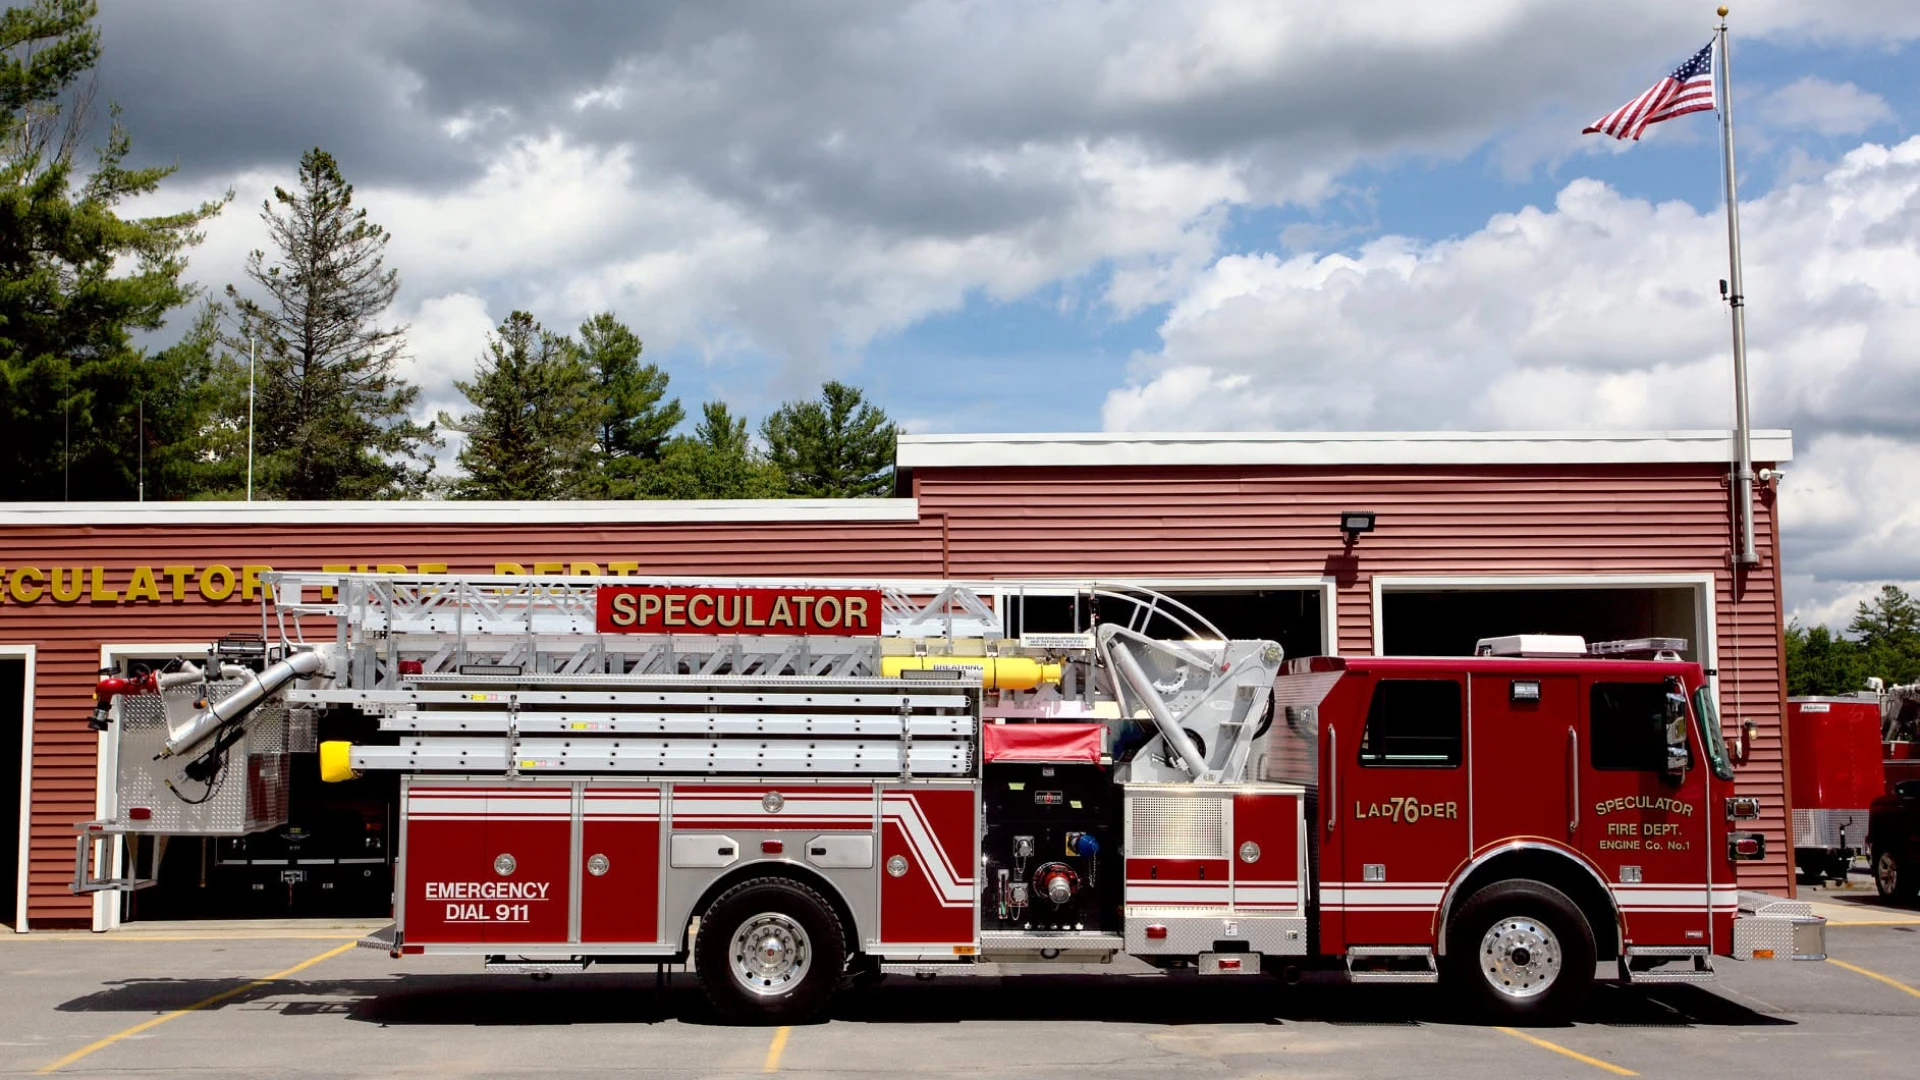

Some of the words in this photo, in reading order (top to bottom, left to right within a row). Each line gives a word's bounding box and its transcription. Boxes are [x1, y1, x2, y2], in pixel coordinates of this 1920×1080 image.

[0, 564, 274, 602] CULATOR
[612, 593, 868, 628] SPECULATOR
[1390, 797, 1419, 823] 76
[1595, 796, 1694, 817] SPECULATOR
[1608, 823, 1638, 836] FIRE
[1643, 823, 1683, 836] DEPT.
[1599, 840, 1641, 850] ENGINE
[425, 882, 550, 899] EMERGENCY
[446, 904, 491, 920] DIAL
[495, 904, 529, 921] 911
